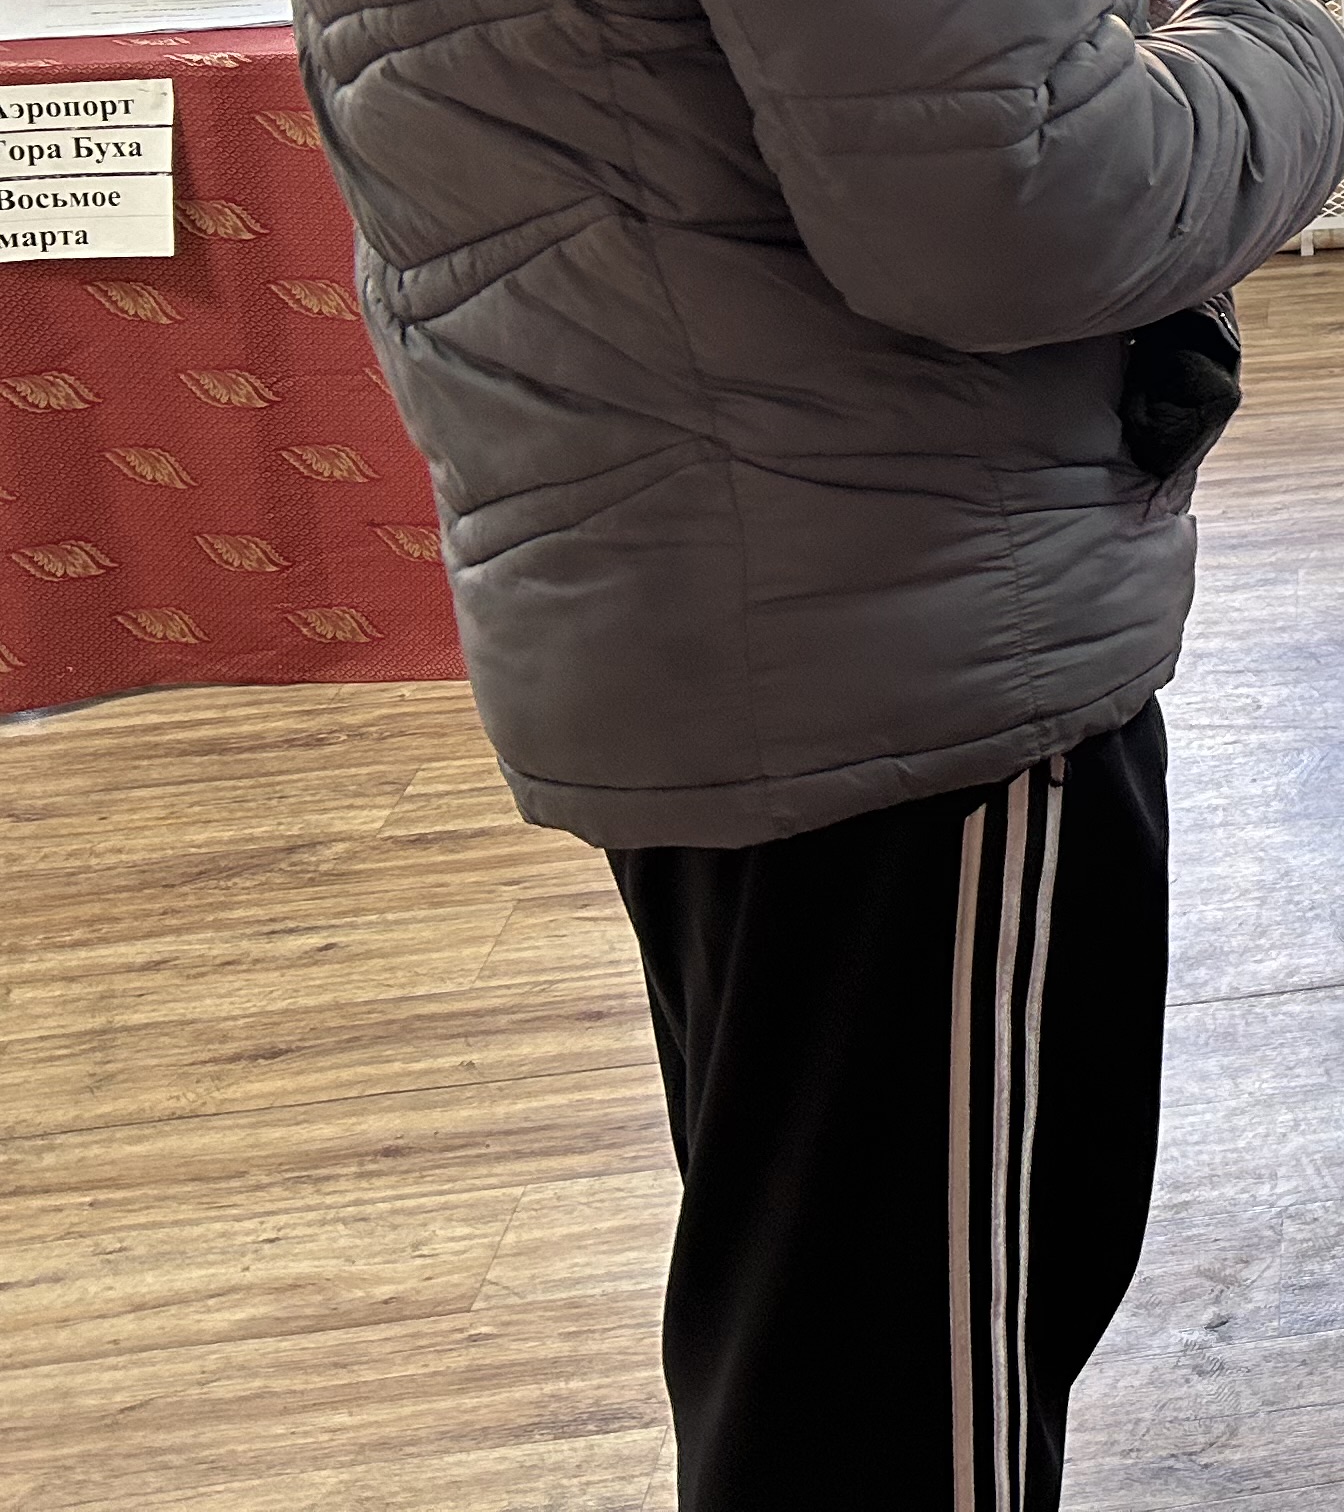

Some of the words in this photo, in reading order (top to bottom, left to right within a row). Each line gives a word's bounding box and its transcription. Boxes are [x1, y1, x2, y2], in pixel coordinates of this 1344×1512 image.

[72, 136, 142, 163] Буха
[0, 189, 120, 210] Восьмое
[0, 228, 88, 252] марта
